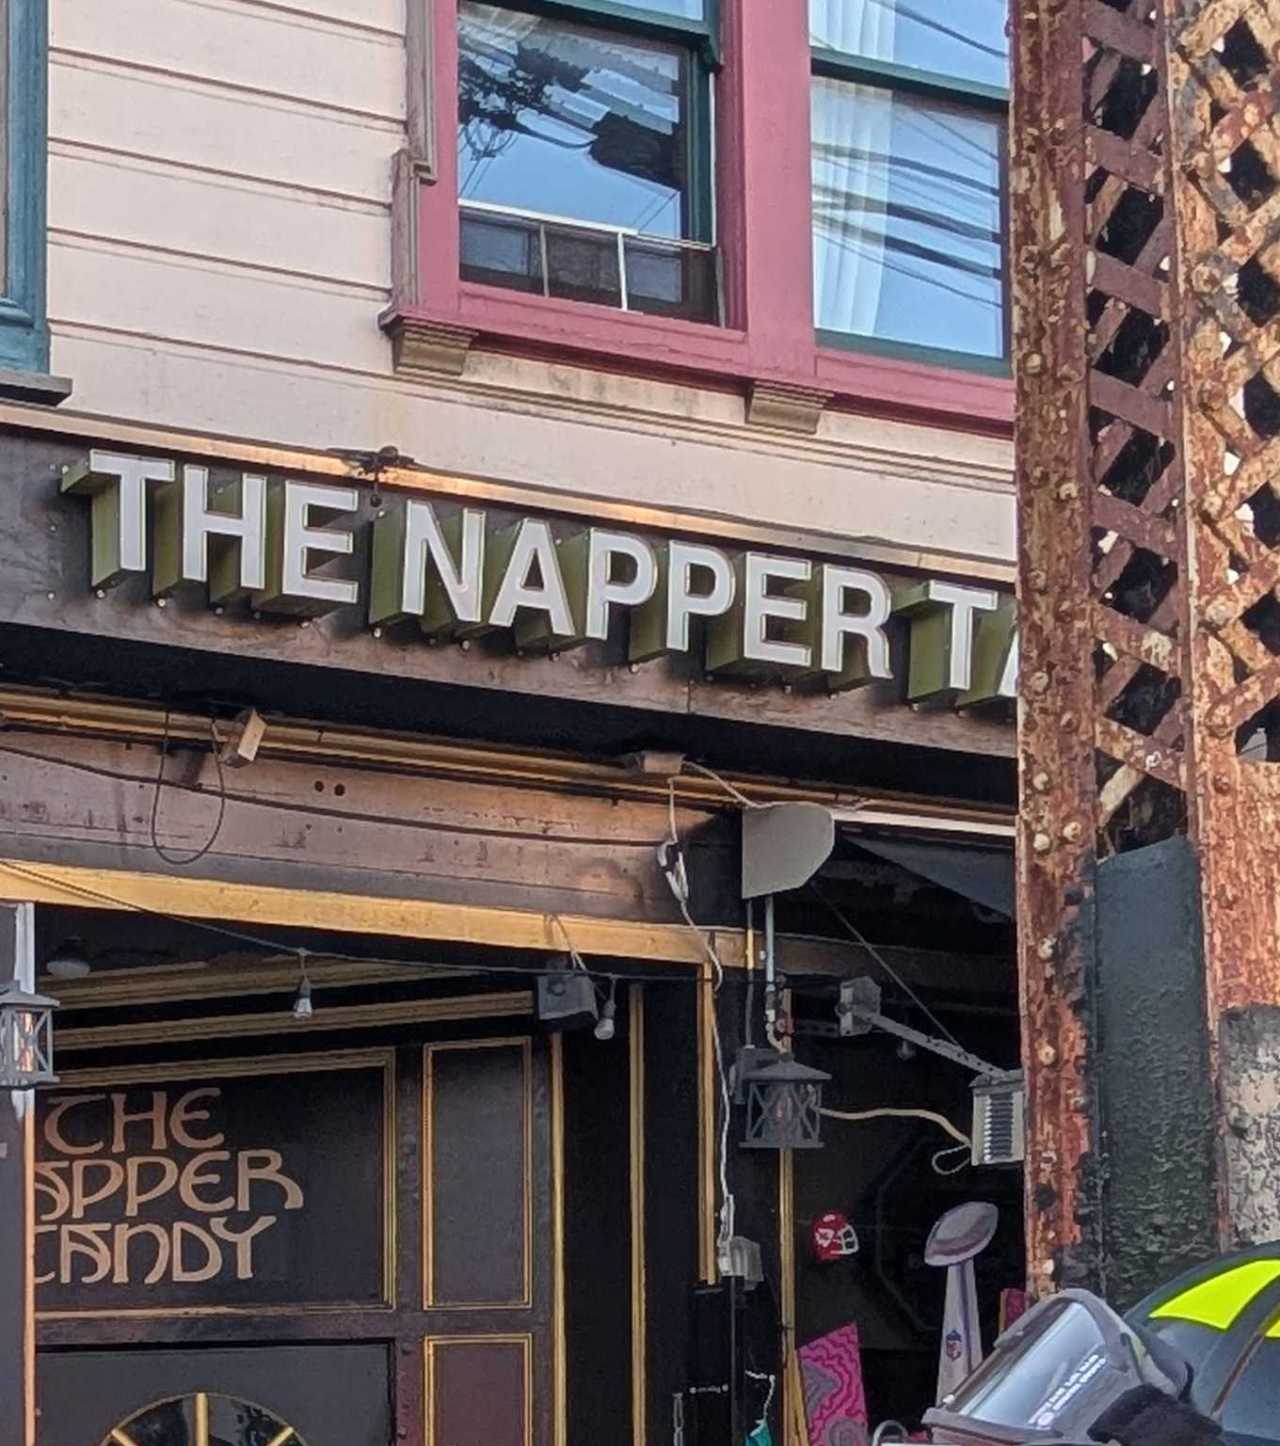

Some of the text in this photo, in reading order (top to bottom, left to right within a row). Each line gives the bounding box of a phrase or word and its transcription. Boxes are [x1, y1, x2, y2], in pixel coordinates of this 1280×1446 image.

[89, 449, 360, 604] THE
[400, 500, 896, 680] NAPPER
[44, 1087, 226, 1155] THE
